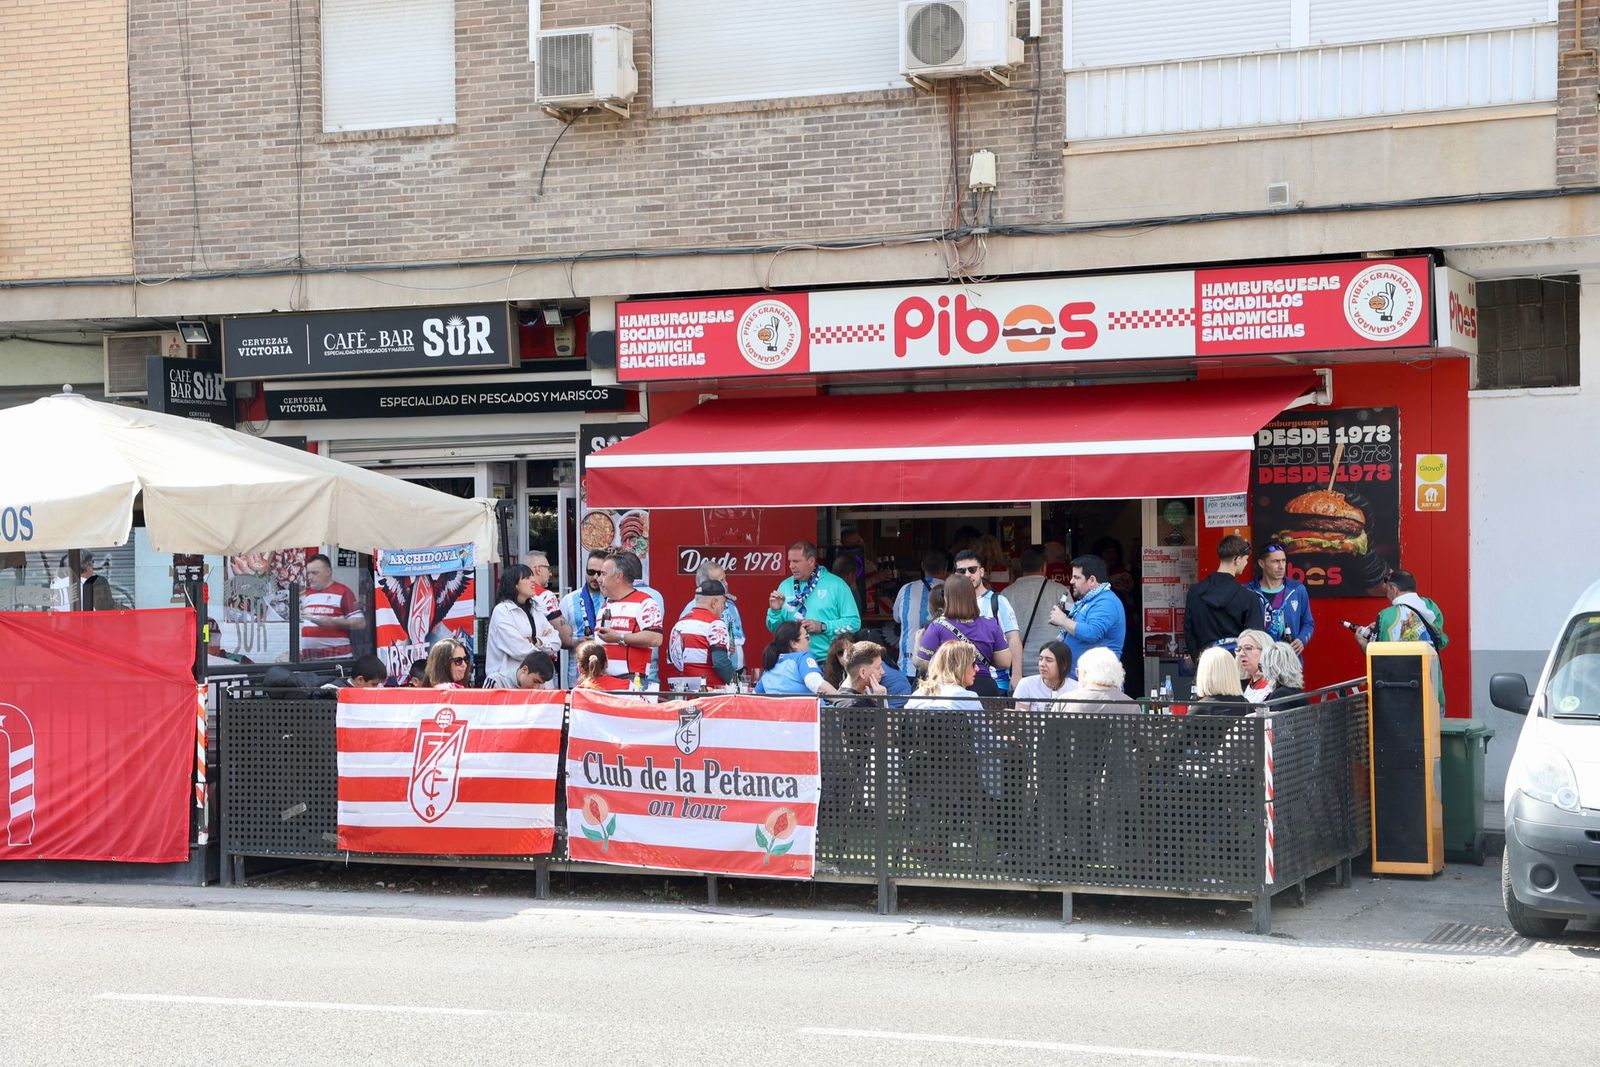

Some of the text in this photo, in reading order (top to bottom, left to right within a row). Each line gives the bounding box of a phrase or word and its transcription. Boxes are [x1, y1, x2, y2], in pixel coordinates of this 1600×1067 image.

[1202, 276, 1340, 297] HAMBURGUESAS
[1352, 272, 1412, 304] PIBES GRANADA
[1202, 293, 1304, 312] BOCADILLOS
[619, 310, 735, 328] HAMBURGUESAS
[744, 307, 793, 336] PIBES GRANADA
[1202, 309, 1289, 327] SANDWICH
[1354, 301, 1414, 333] PIBES GRANADA
[242, 337, 289, 347] CERVEZAS
[324, 329, 368, 351] CAFÉ
[379, 329, 415, 348] BAR
[423, 315, 495, 357] SUR
[619, 325, 704, 342] BOCADILLOS
[1202, 324, 1305, 342] SALCHICHAS
[238, 345, 293, 357] VICTORIA
[619, 340, 693, 356] SANDWICH
[746, 333, 795, 362] PIBES GRANADA
[619, 353, 706, 369] SALCHICHAS
[170, 368, 192, 383] CAFÉ
[171, 382, 192, 399] BAR
[194, 371, 227, 401] SUR
[380, 389, 609, 407] ESPECIALIDAD EN PESCADOS Y MARISCOS
[280, 404, 328, 413] VICTORIA
[1258, 425, 1392, 447] DESDE 1978
[1258, 446, 1331, 466] DESDE
[1259, 464, 1392, 484] DESDE 1978
[0, 505, 34, 542] OS
[389, 551, 458, 565] ARCHIDONA
[744, 552, 783, 571] 1978
[583, 751, 799, 798] Club de la Petanca
[649, 798, 727, 820] on tour
